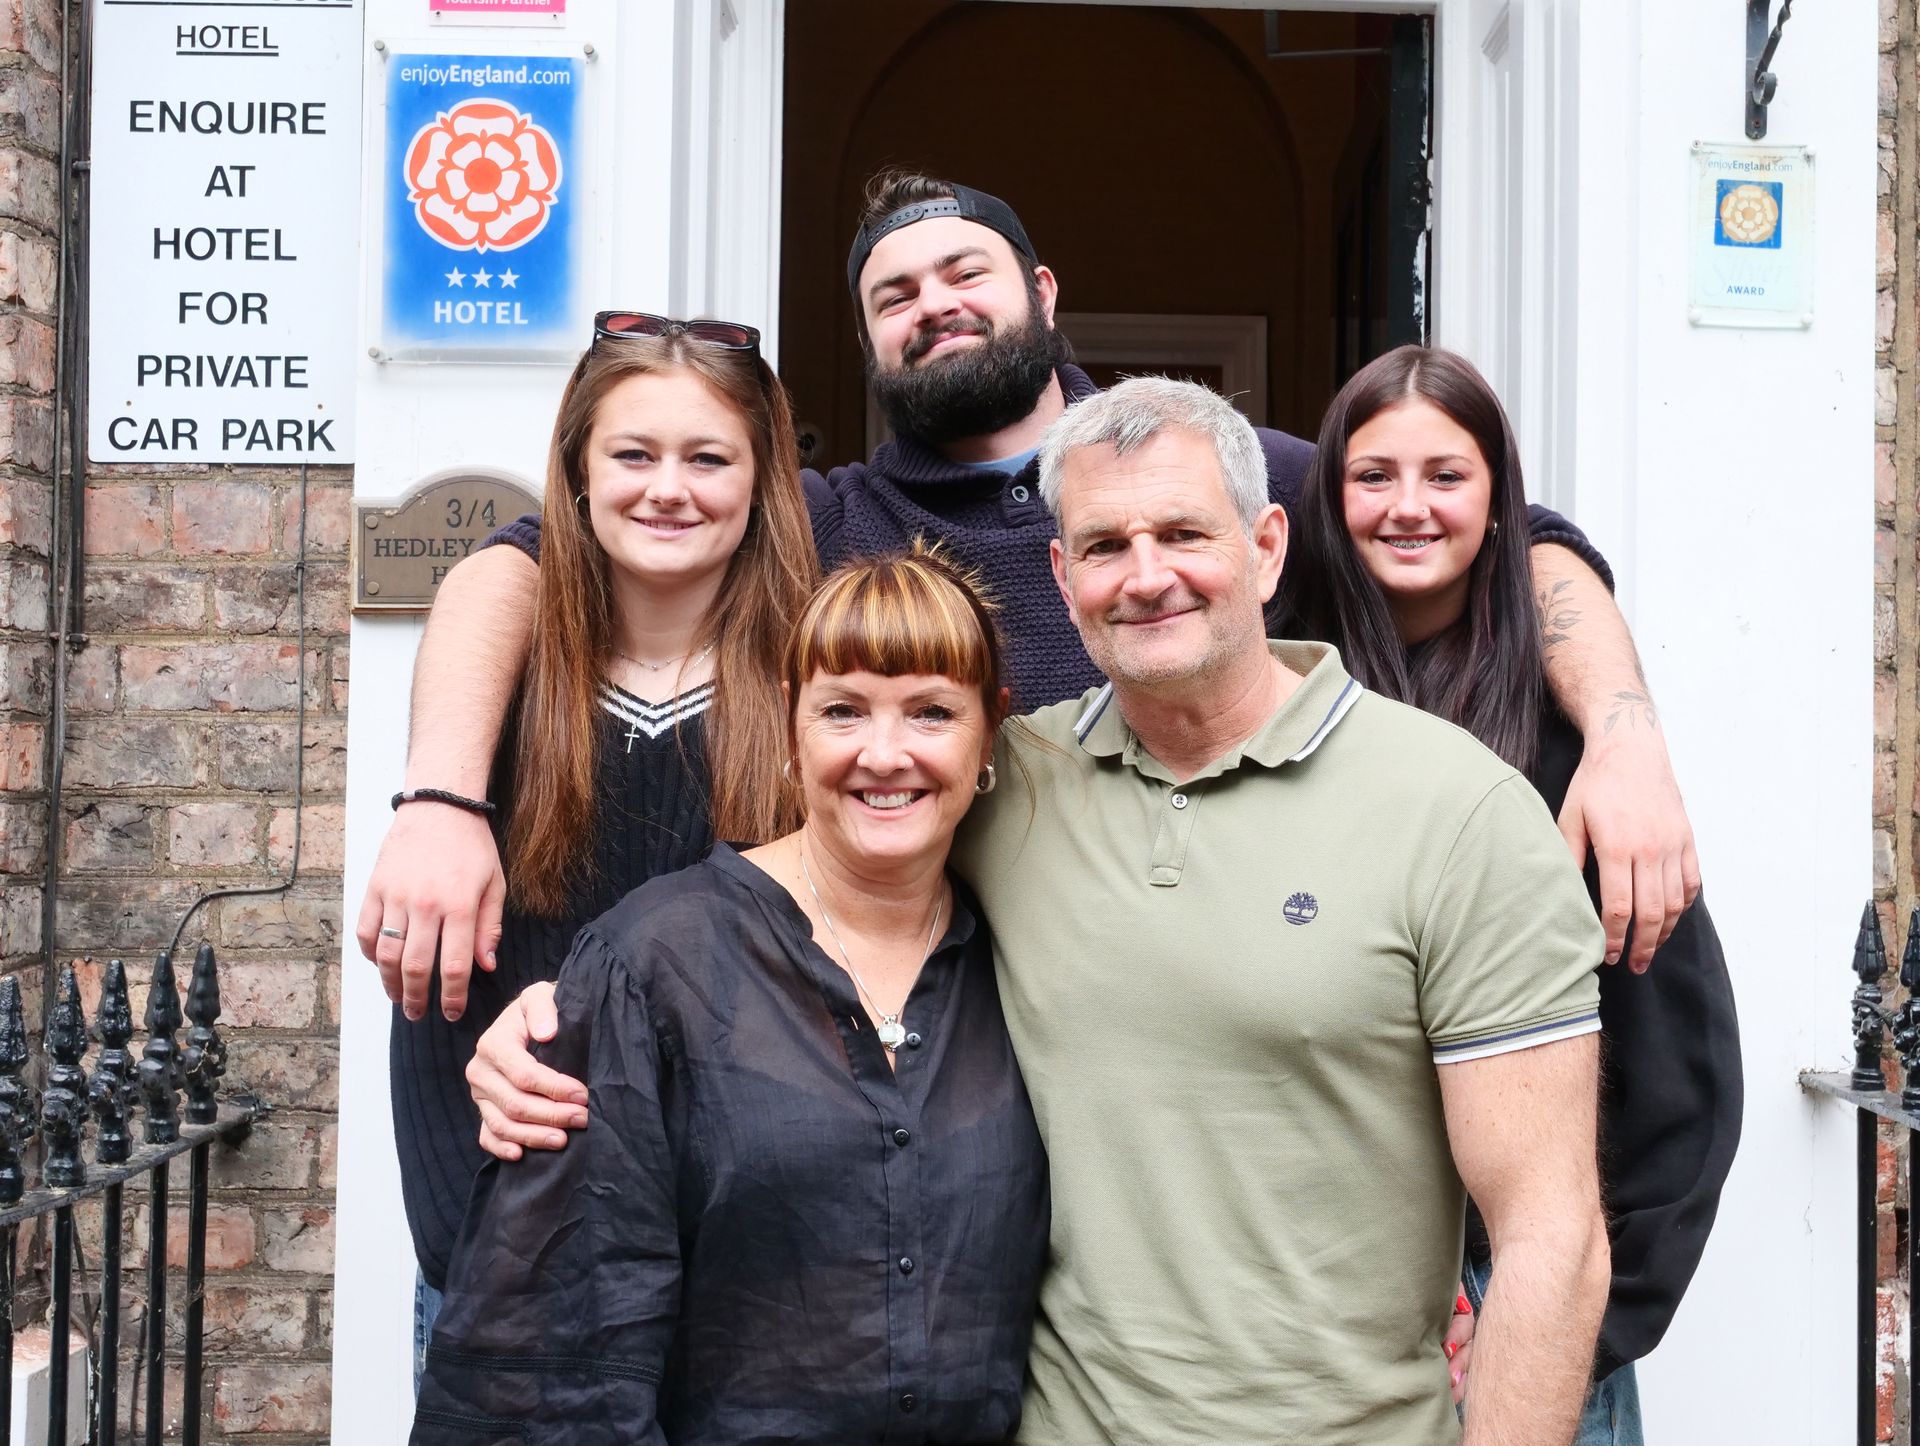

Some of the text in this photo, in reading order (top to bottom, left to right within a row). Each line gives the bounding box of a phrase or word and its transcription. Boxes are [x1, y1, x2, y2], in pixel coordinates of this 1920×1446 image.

[176, 25, 279, 49] HOTEL
[401, 64, 570, 87] enjoyEngland.com
[129, 100, 326, 135] ENQUIRE
[204, 165, 256, 198] AT
[153, 227, 297, 261] HOTEL
[1726, 284, 1766, 296] AWARD
[179, 291, 268, 325] FOR
[433, 301, 529, 325] HOTEL
[137, 354, 309, 388] PRIVATE
[108, 416, 336, 452] CAR PARK
[446, 498, 497, 528] 3/4
[373, 538, 476, 558] HEDLEY
